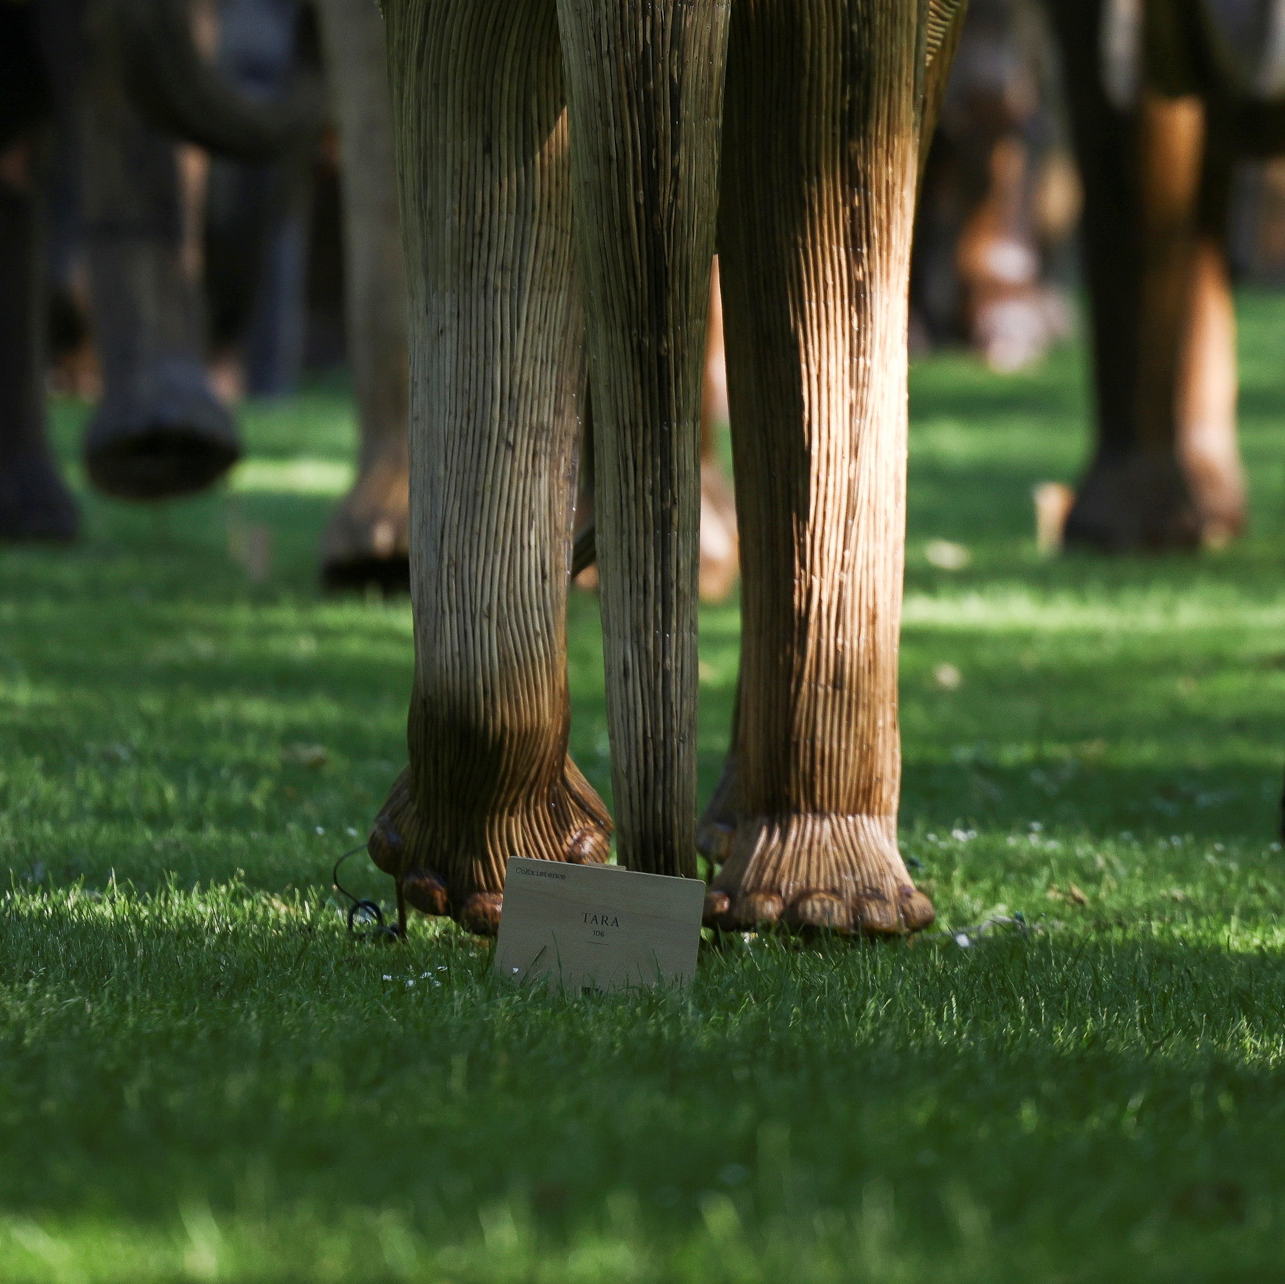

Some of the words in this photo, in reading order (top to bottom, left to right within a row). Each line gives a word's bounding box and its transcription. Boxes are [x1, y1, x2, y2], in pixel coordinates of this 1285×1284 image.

[515, 867, 567, 880] CoExistence
[581, 912, 620, 927] TARA
[593, 929, 605, 938] 106
